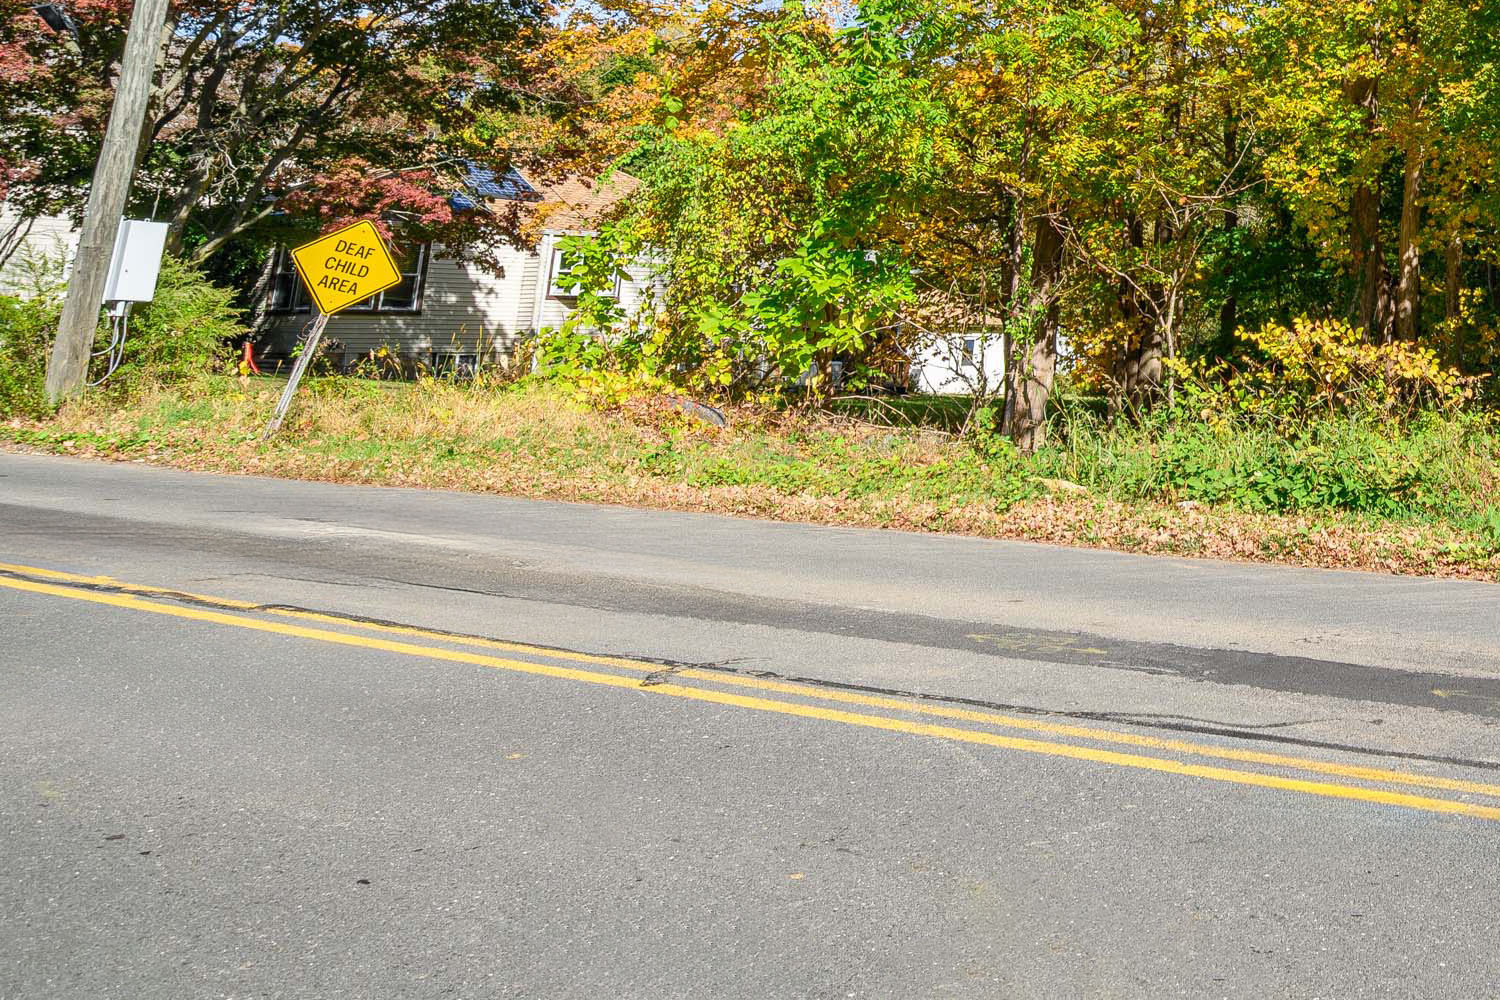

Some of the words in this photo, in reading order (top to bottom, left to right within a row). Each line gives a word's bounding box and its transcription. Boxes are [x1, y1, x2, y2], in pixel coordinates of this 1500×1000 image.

[335, 240, 376, 259] DEAF
[324, 256, 369, 278] CHILD
[317, 275, 358, 295] AREA
